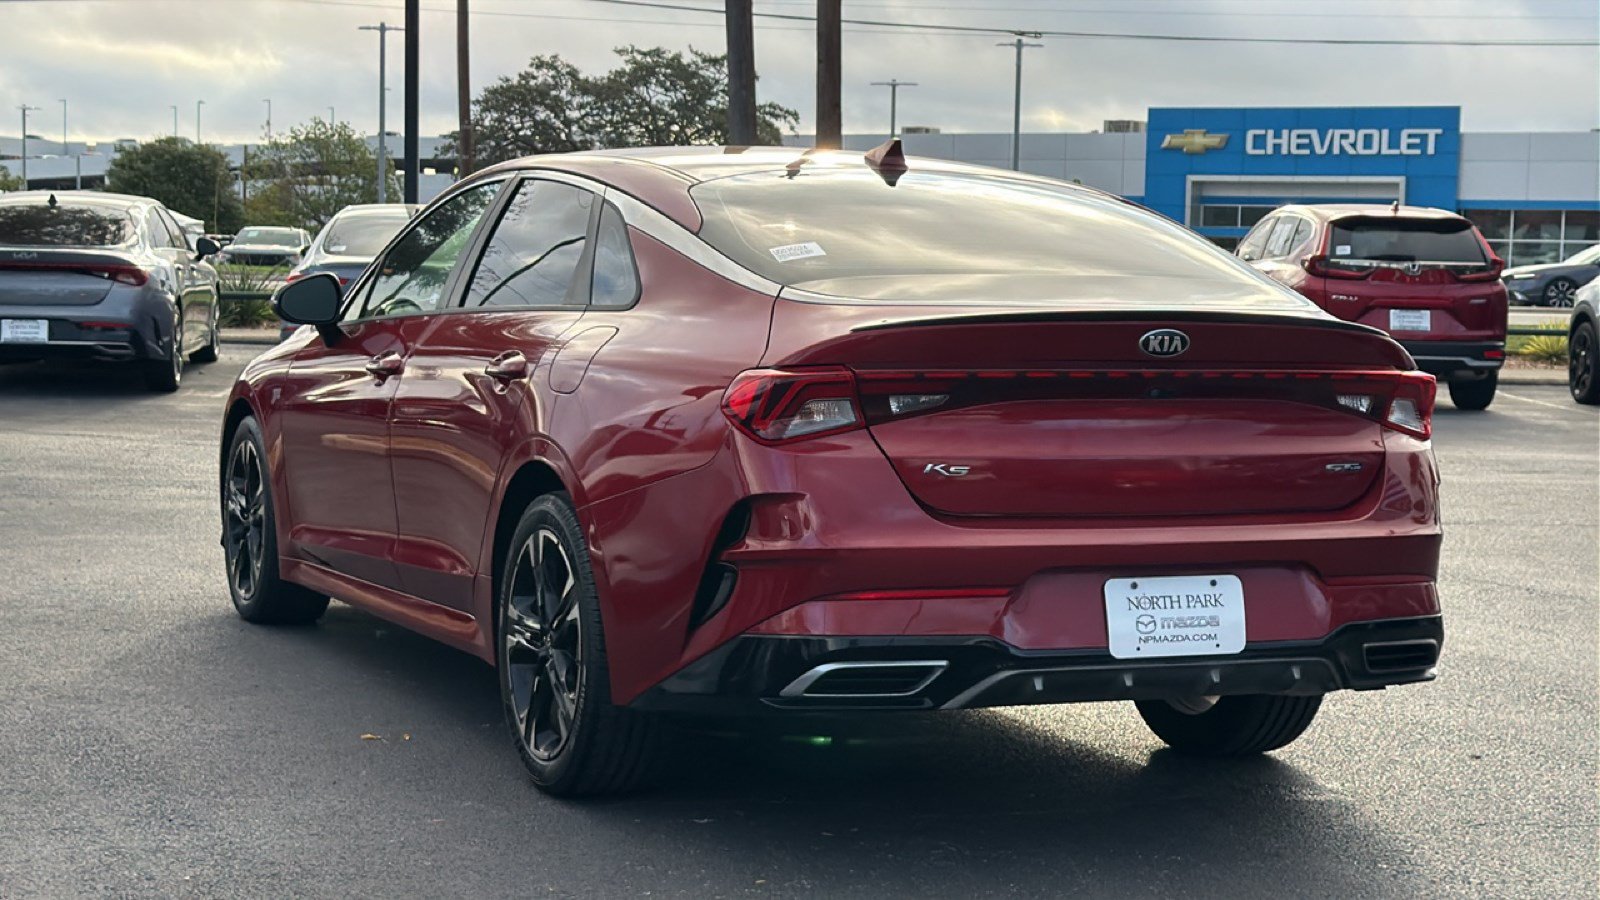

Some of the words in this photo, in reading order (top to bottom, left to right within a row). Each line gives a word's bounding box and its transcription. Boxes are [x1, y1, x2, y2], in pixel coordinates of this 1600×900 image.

[1245, 128, 1444, 155] CHEVROLET
[1148, 335, 1182, 352] KIA
[923, 463, 971, 476] K5
[1126, 593, 1181, 611] NORTH
[1185, 593, 1224, 608] PARK
[1160, 615, 1220, 629] mazda
[1138, 633, 1218, 644] NPMAZDA.COM
